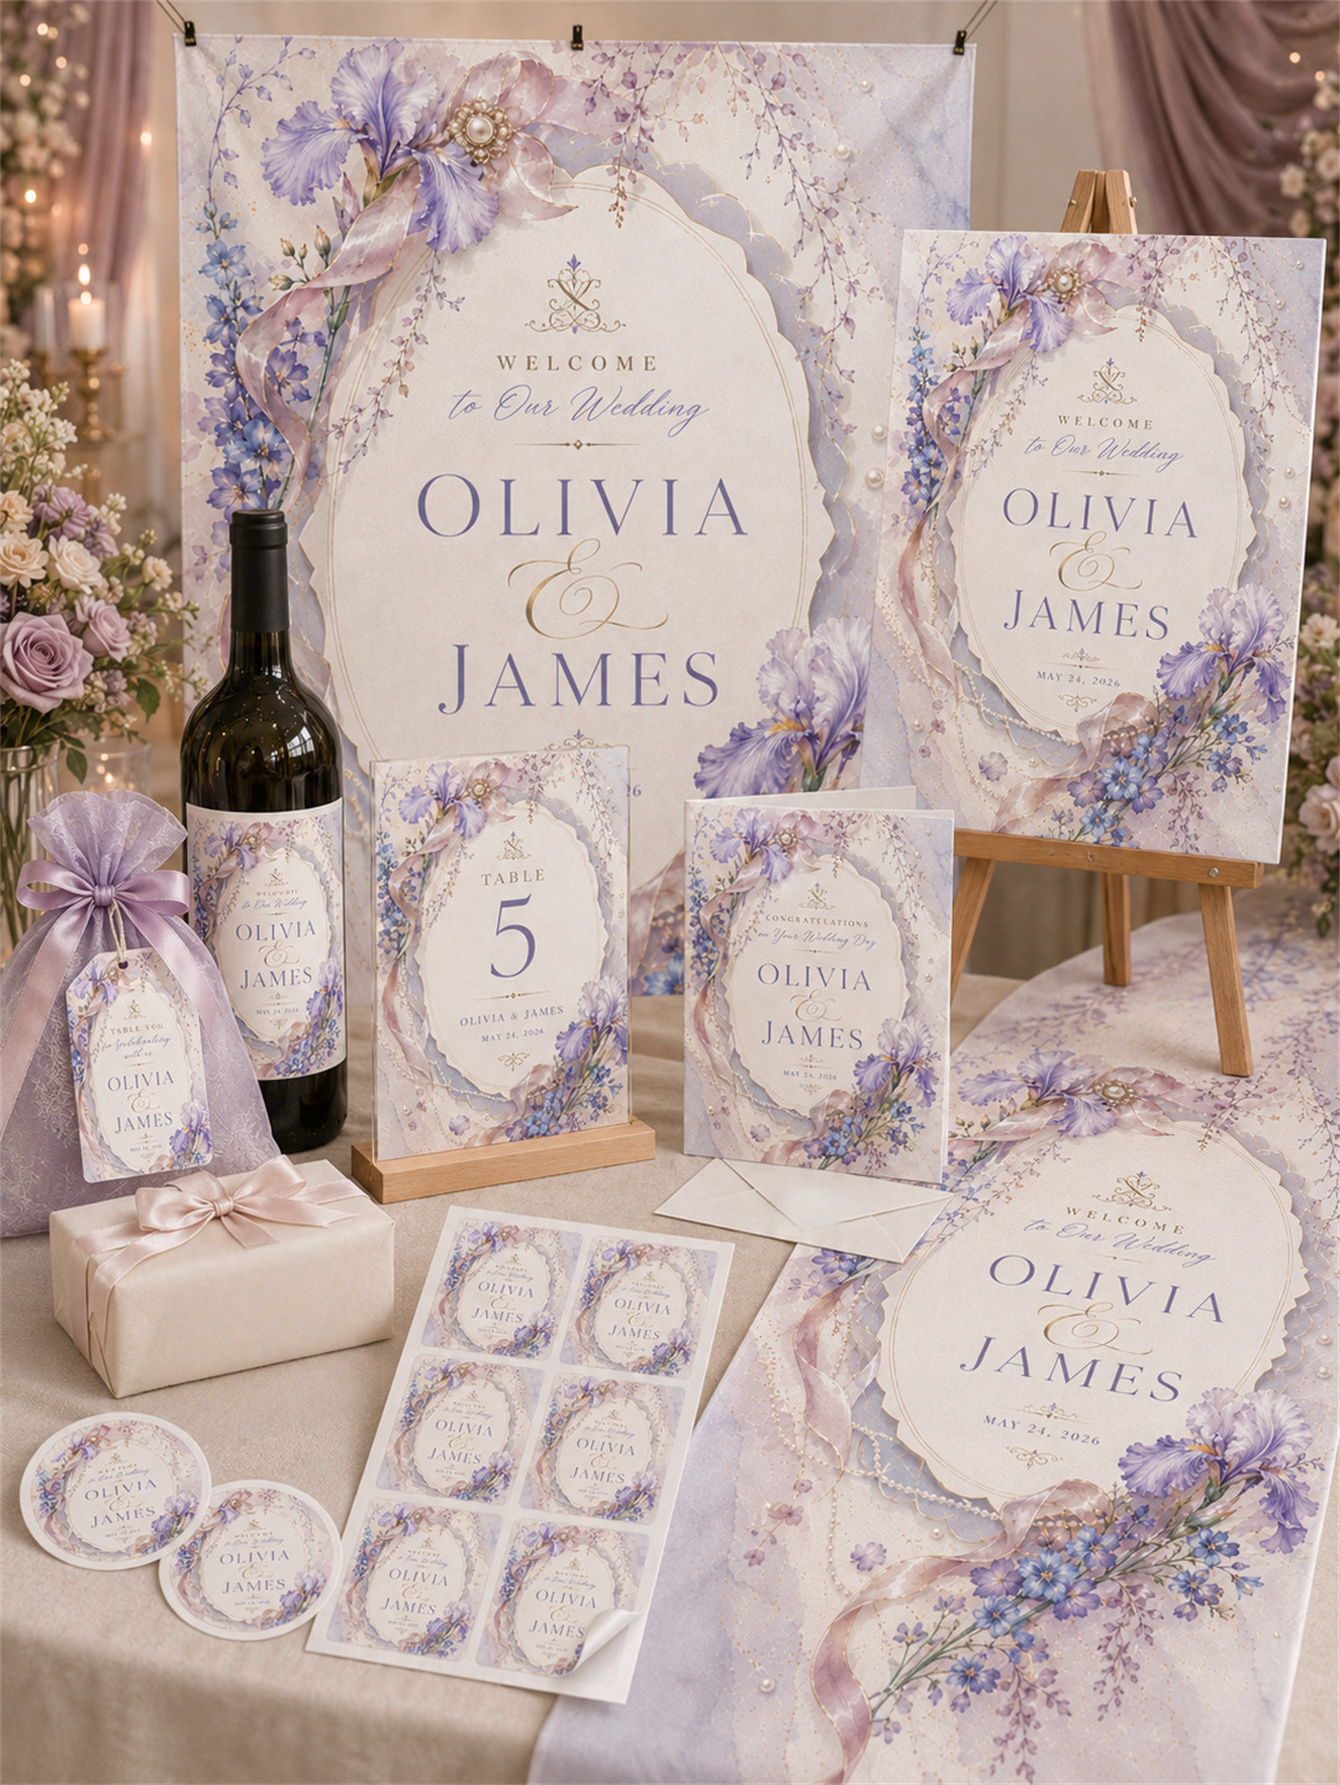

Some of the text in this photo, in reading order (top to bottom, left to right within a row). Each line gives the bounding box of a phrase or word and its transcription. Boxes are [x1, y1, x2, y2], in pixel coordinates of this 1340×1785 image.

[497, 354, 658, 372] WELCOME
[448, 384, 710, 438] to Our Wedding
[1058, 415, 1153, 430] WELCOME
[1024, 434, 1184, 473] to Our Wedding
[417, 473, 749, 538] OLIVIA
[1003, 488, 1198, 538] OLIVIA
[1050, 531, 1143, 592] &
[507, 538, 669, 640] &
[1004, 589, 1170, 640] JAMES
[438, 644, 718, 715] JAMES
[1037, 671, 1063, 681] MAY
[1092, 676, 1120, 687] 2026
[481, 868, 546, 886] TABLE
[236, 920, 316, 941] OLIVIA
[490, 893, 535, 978] 5
[258, 940, 299, 968] &
[240, 967, 312, 990] JAMES
[758, 963, 871, 991] OLIVIA
[460, 1005, 564, 1027] OLIVIA & JAMES
[790, 989, 842, 1022] &
[482, 1033, 502, 1042] MAY
[762, 1020, 863, 1050] JAMES
[107, 1070, 174, 1092] OLIVIA
[127, 1089, 160, 1113] &
[115, 1111, 173, 1134] JAMES
[1066, 1207, 1185, 1235] WELCOME
[1023, 1219, 1216, 1268] to Our Wedding
[478, 1281, 533, 1298] OLIVIA
[989, 1255, 1224, 1323] OLIVIA
[471, 1308, 523, 1323] JAMES
[614, 1298, 670, 1315] OLIVIA
[608, 1325, 660, 1340] JAMES
[1038, 1302, 1153, 1355] &
[960, 1336, 1183, 1402] JAMES
[435, 1420, 492, 1437] OLIVIA
[983, 1415, 1021, 1430] MAY
[1061, 1430, 1100, 1446] 2026
[428, 1448, 481, 1464] JAMES
[576, 1438, 634, 1456] OLIVIA
[570, 1467, 624, 1484] JAMES
[85, 1479, 156, 1500] OLIVIA
[91, 1507, 155, 1528] JAMES
[220, 1550, 289, 1564] OLIVIA
[222, 1579, 285, 1594] JAMES
[389, 1568, 448, 1586] OLIVIA
[381, 1597, 436, 1615] JAMES
[536, 1589, 596, 1608] OLIVIA
[529, 1620, 585, 1639] JAMES
